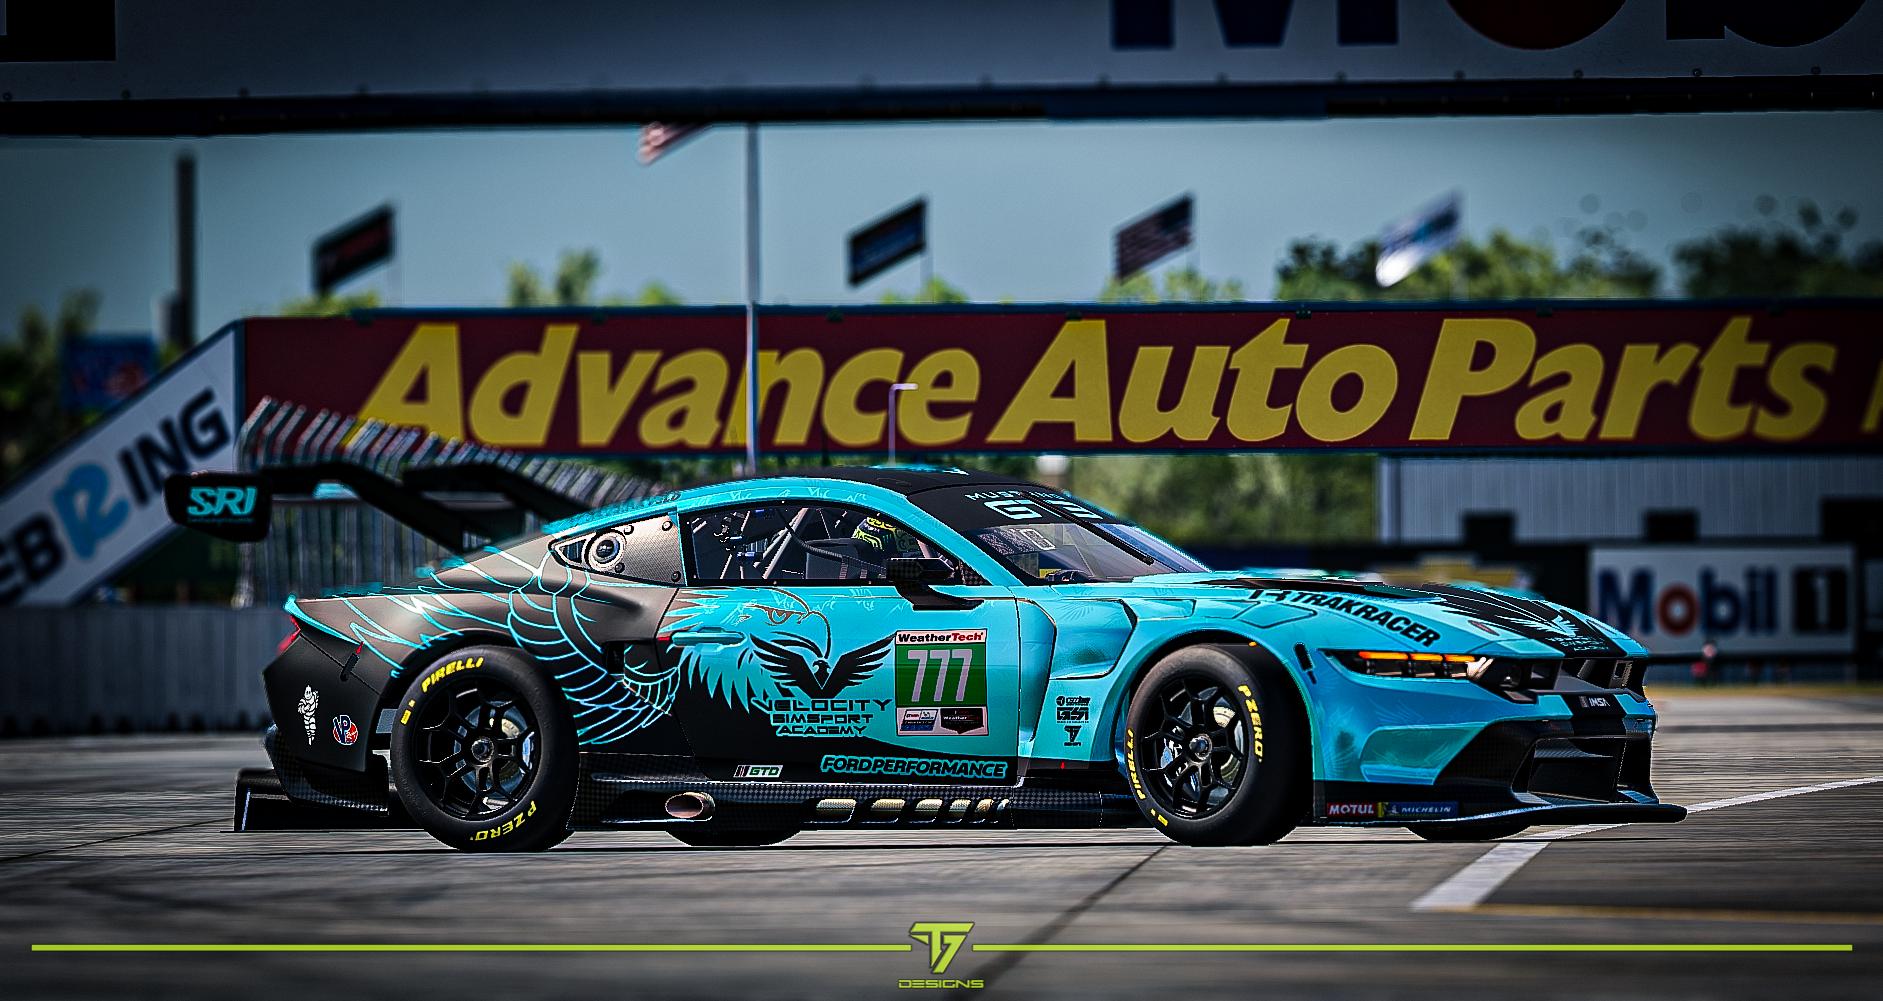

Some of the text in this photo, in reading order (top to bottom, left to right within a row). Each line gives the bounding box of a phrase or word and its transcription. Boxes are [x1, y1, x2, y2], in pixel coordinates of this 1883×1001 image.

[346, 323, 980, 447] Advance
[985, 318, 1399, 442] Auto
[1409, 317, 1837, 441] Parts
[187, 487, 257, 515] SRI
[1597, 566, 1777, 636] Mobil
[1290, 591, 1441, 648] TRAKRACER
[897, 632, 983, 643] WeatherTech
[421, 657, 484, 692] PIRELLI
[907, 649, 973, 702] 777
[751, 699, 892, 712] VELOCITY
[771, 713, 874, 724] SIMSPORT
[777, 725, 867, 735] ACADEMY
[748, 766, 781, 776] GTD
[1329, 804, 1375, 815] MOTUL
[475, 813, 527, 841] ZERO
